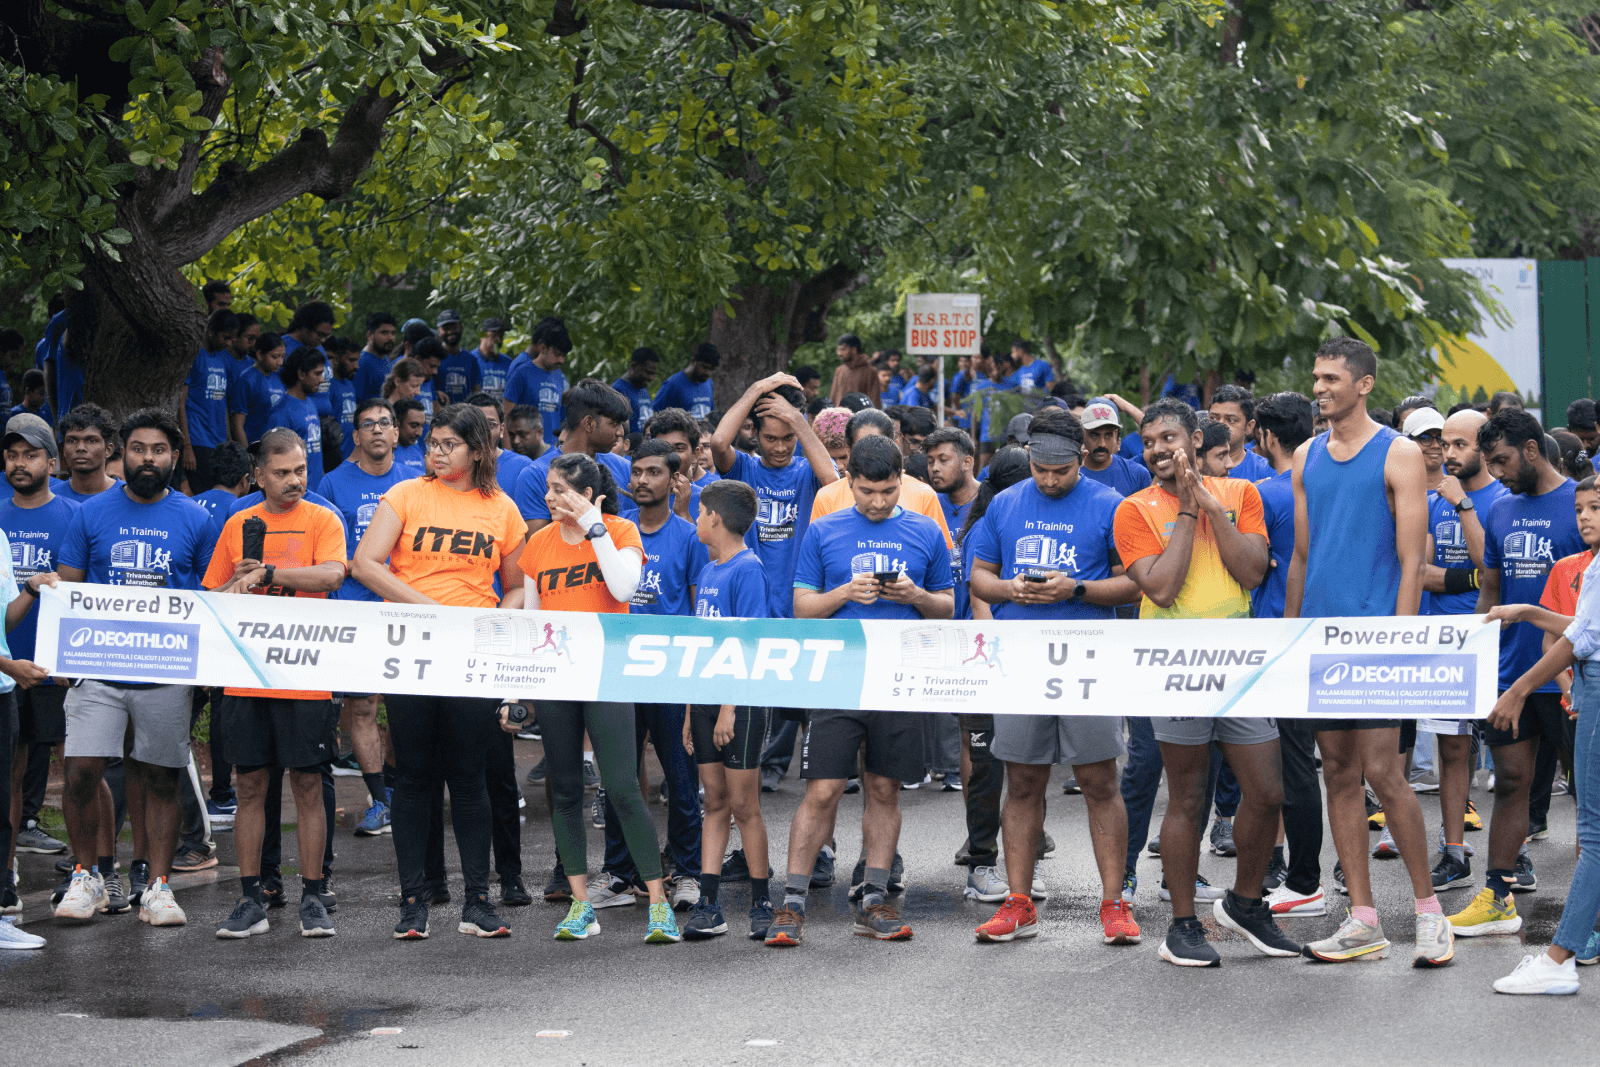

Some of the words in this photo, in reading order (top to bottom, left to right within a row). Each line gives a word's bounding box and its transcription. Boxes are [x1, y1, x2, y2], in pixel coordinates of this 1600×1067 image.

[911, 329, 938, 347] BUS
[944, 329, 976, 348] STOP
[1092, 407, 1111, 419] W
[1025, 520, 1034, 529] In
[1036, 520, 1074, 534] Training
[1512, 519, 1520, 527] In
[1521, 518, 1551, 529] Training
[9, 530, 17, 538] In
[19, 530, 49, 540] Training
[119, 527, 129, 535] In
[131, 527, 168, 539] Training
[412, 526, 495, 559] ITEN
[857, 540, 866, 549] In
[867, 540, 902, 551] Training
[126, 572, 163, 580] Trivandrum
[70, 591, 160, 613] Powered
[168, 596, 194, 620] By
[380, 610, 399, 618] TITLE
[237, 622, 357, 644] TRAINING
[1324, 625, 1430, 645] Powered
[1438, 625, 1469, 650] By
[94, 630, 188, 650] DECATHLON
[63, 651, 104, 659] KALAMASSERY
[265, 647, 321, 666] RUN
[622, 634, 845, 682] START
[1133, 648, 1267, 666] TRAINING
[496, 663, 556, 673] Trivandrum
[1352, 666, 1464, 683] DECATHLON
[494, 674, 546, 684] Marathon
[925, 676, 988, 685] Trivandrum
[1164, 674, 1226, 691] RUN
[922, 687, 977, 696] Marathon
